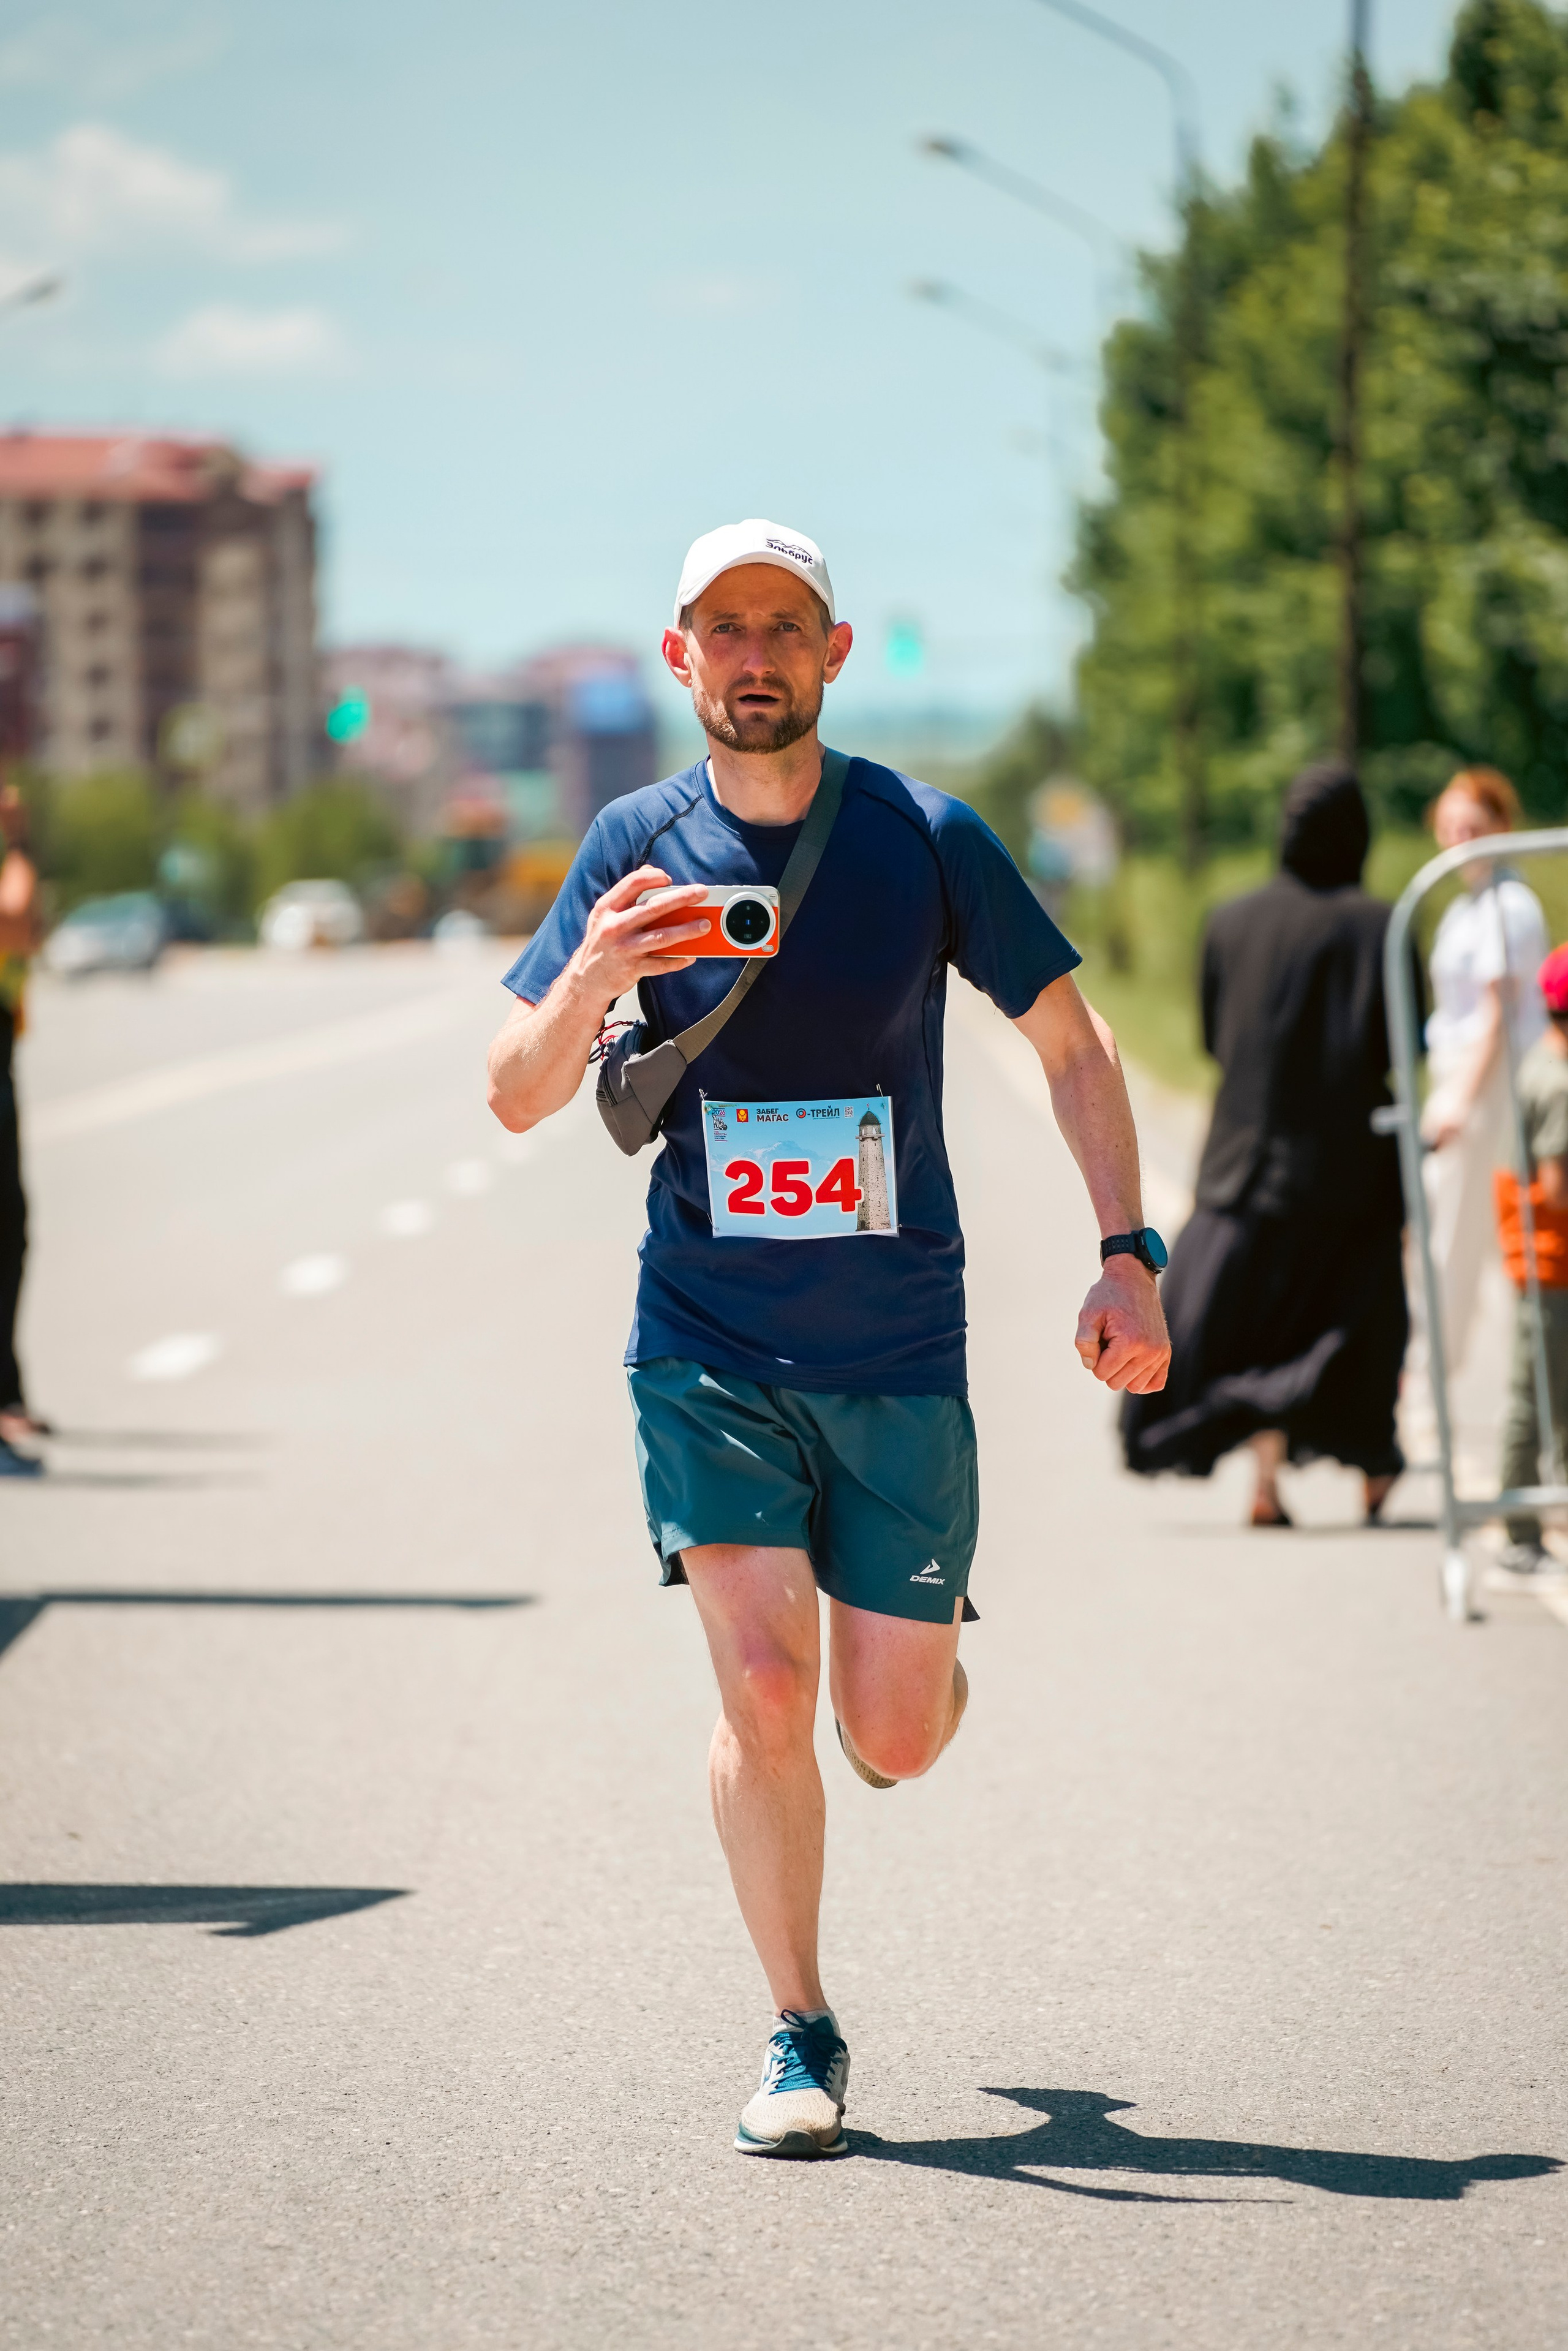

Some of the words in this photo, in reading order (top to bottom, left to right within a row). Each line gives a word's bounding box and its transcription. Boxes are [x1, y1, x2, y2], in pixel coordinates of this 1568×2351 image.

[766, 541, 813, 565] Эльбрус
[725, 1158, 862, 1217] 254
[910, 1575, 945, 1585] DEMIX
